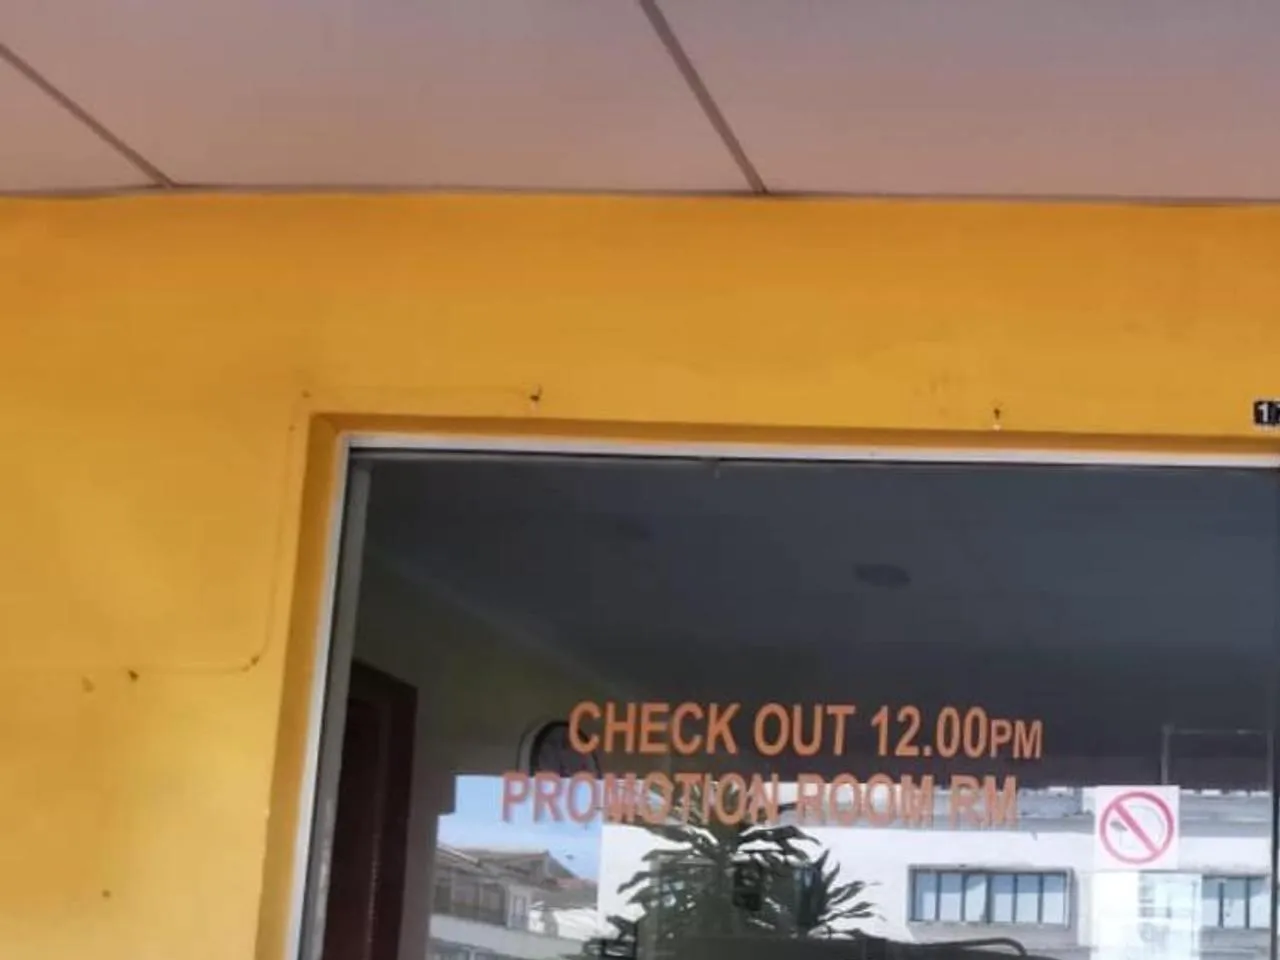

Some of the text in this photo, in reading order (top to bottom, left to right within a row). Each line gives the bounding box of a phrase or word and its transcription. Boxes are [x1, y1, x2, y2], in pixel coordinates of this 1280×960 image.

[568, 701, 1044, 760] CHECK OUT 12.00PM
[501, 770, 1019, 831] PROMOTION ROOM RM
